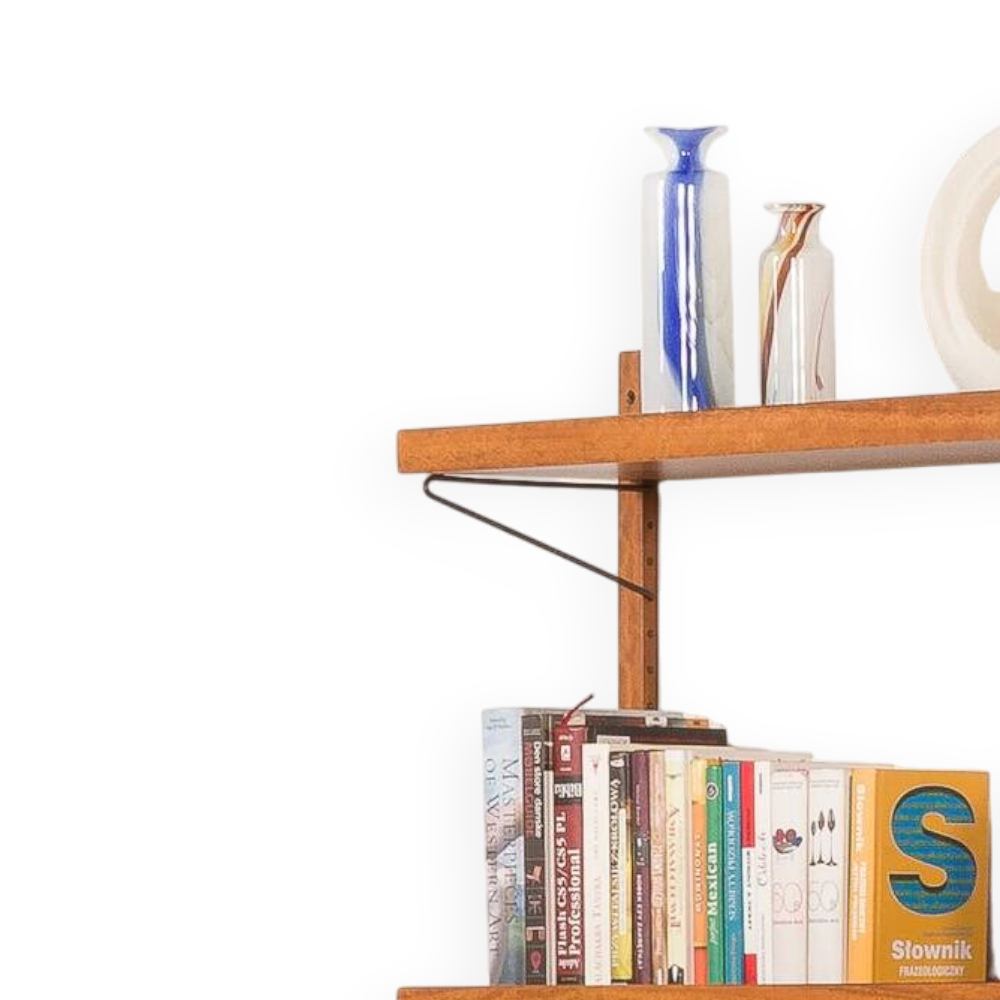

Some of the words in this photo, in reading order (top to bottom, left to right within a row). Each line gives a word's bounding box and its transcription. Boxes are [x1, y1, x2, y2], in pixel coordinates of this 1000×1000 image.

[533, 741, 542, 764] Den
[533, 765, 542, 795] store
[502, 758, 519, 924] MASTERPIECES
[556, 811, 567, 833] PL
[486, 794, 500, 904] WESTERN
[707, 842, 718, 915] Mexican
[568, 849, 581, 956] Professional
[557, 911, 567, 956] Flash
[891, 939, 973, 961] Słownik
